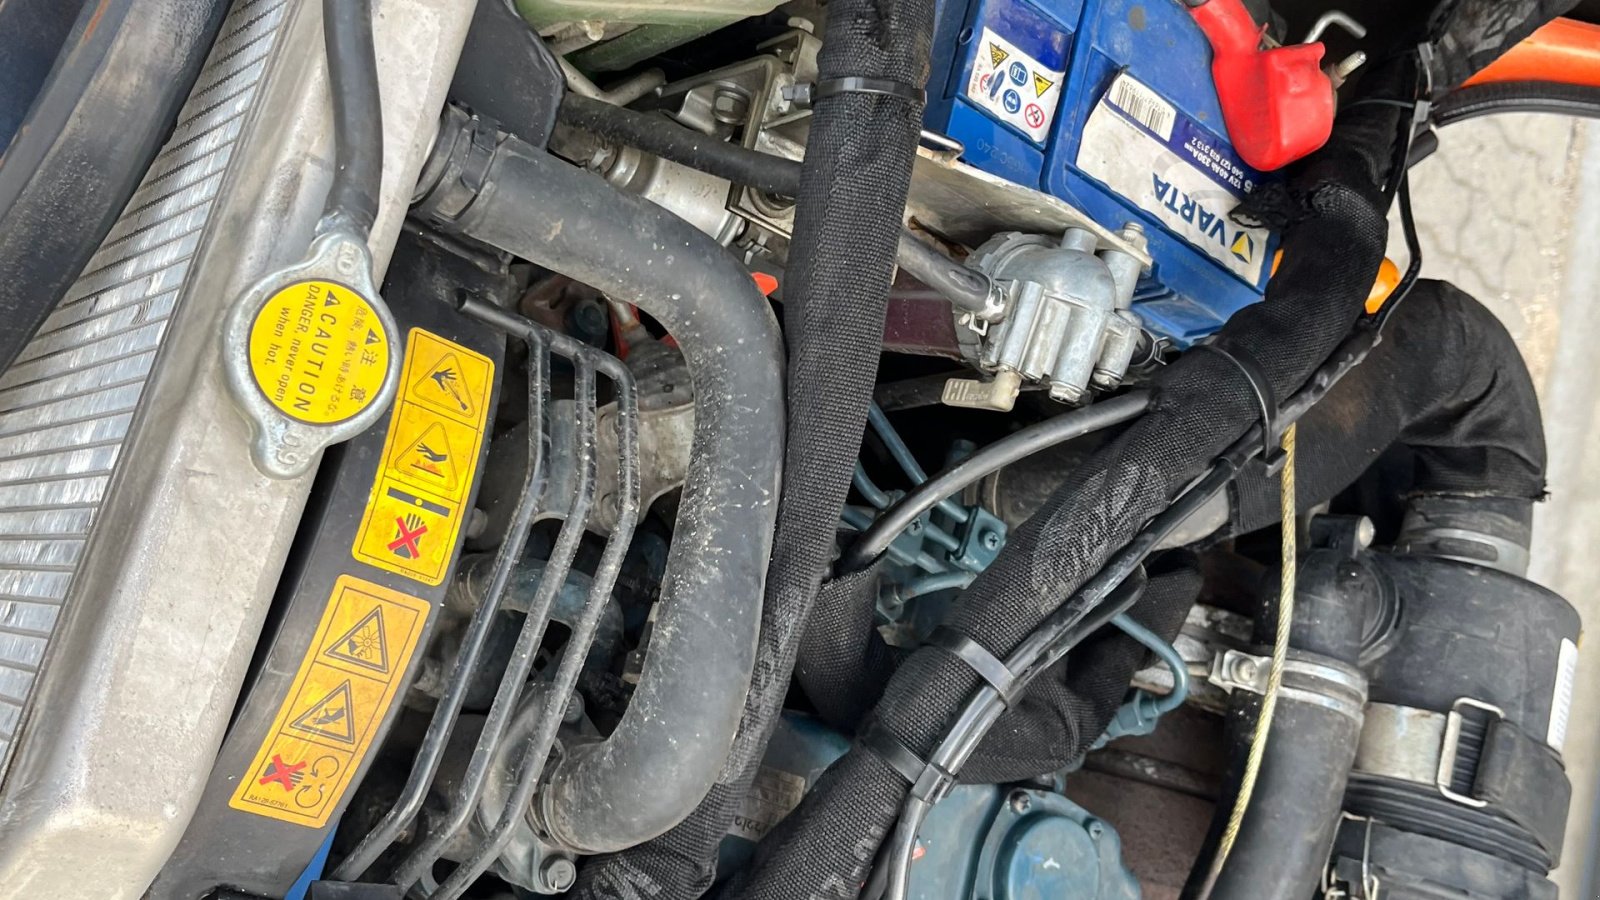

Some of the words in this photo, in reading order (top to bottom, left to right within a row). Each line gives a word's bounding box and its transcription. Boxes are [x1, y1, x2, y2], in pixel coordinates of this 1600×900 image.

[1211, 162, 1229, 179] 40Ah
[1228, 174, 1241, 189] 12V
[1152, 172, 1226, 248] VARTA
[274, 306, 291, 338] when
[294, 284, 321, 334] DANGER,
[264, 343, 282, 366] hot.
[284, 339, 301, 372] never
[293, 313, 337, 412] CAUTION
[275, 374, 290, 402] open
